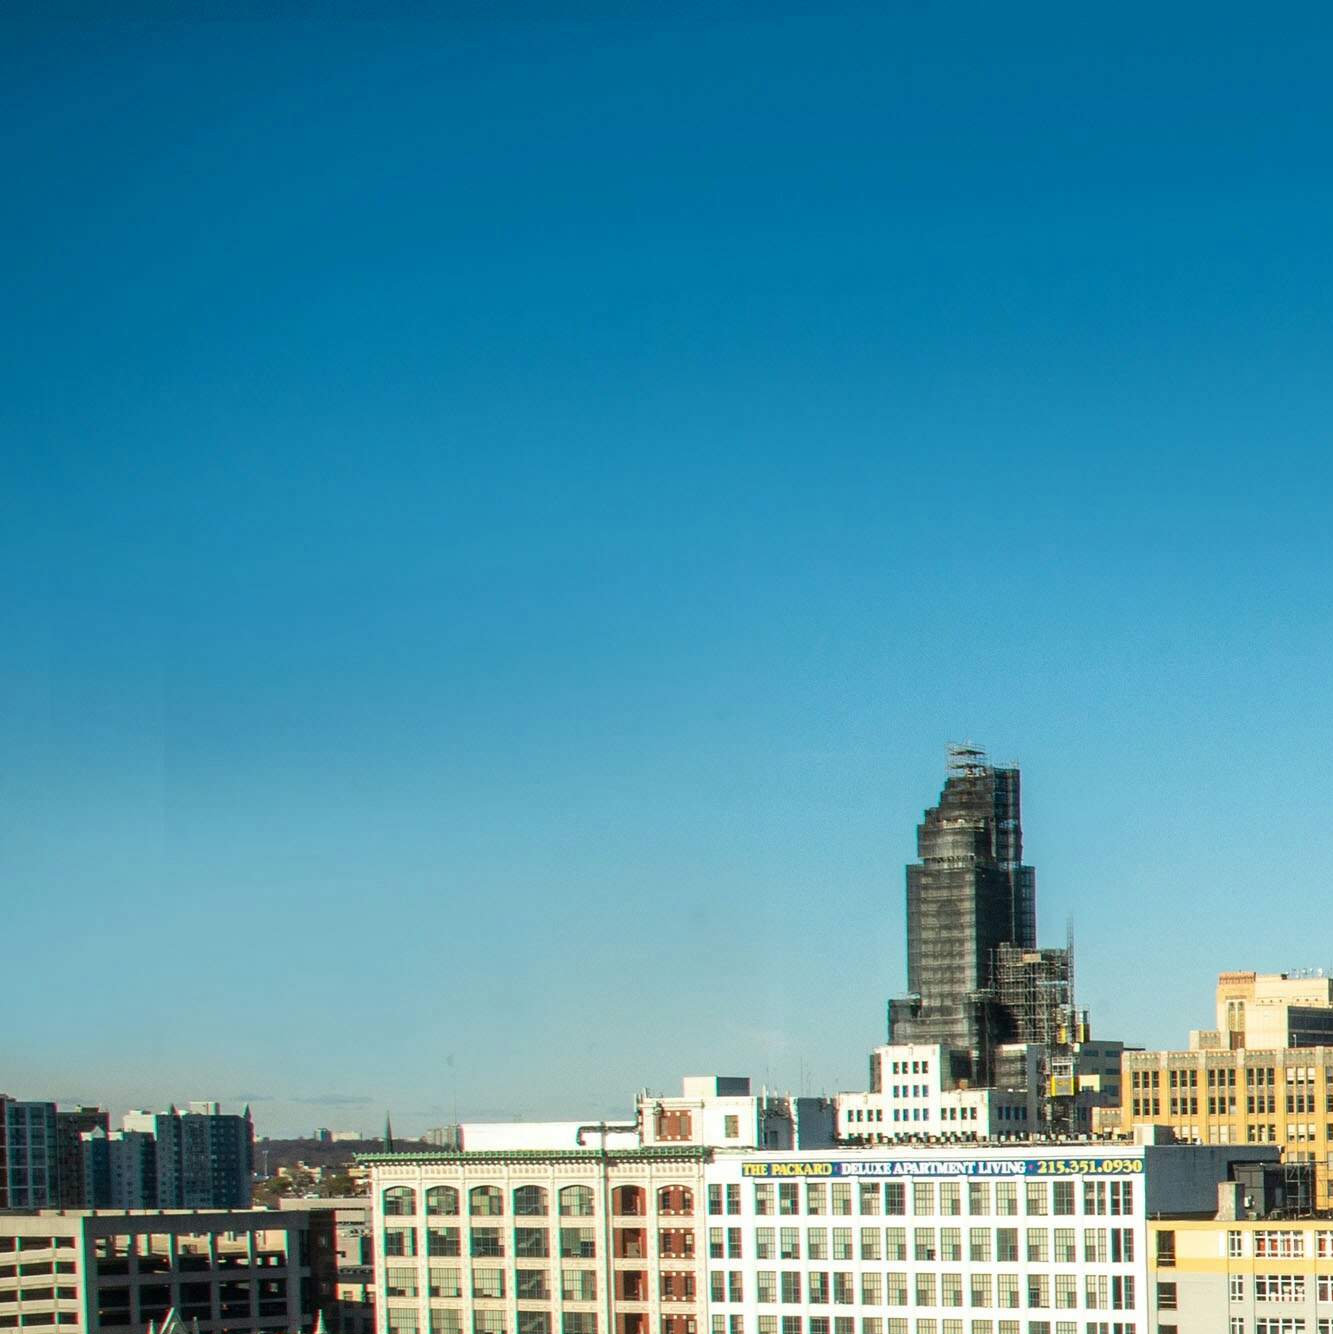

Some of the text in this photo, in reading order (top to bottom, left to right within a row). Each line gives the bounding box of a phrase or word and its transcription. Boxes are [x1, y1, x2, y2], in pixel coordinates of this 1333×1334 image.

[743, 1160, 1142, 1175] THE PACKARD DELUXE APARTMENT LIVING 215.351.0930
